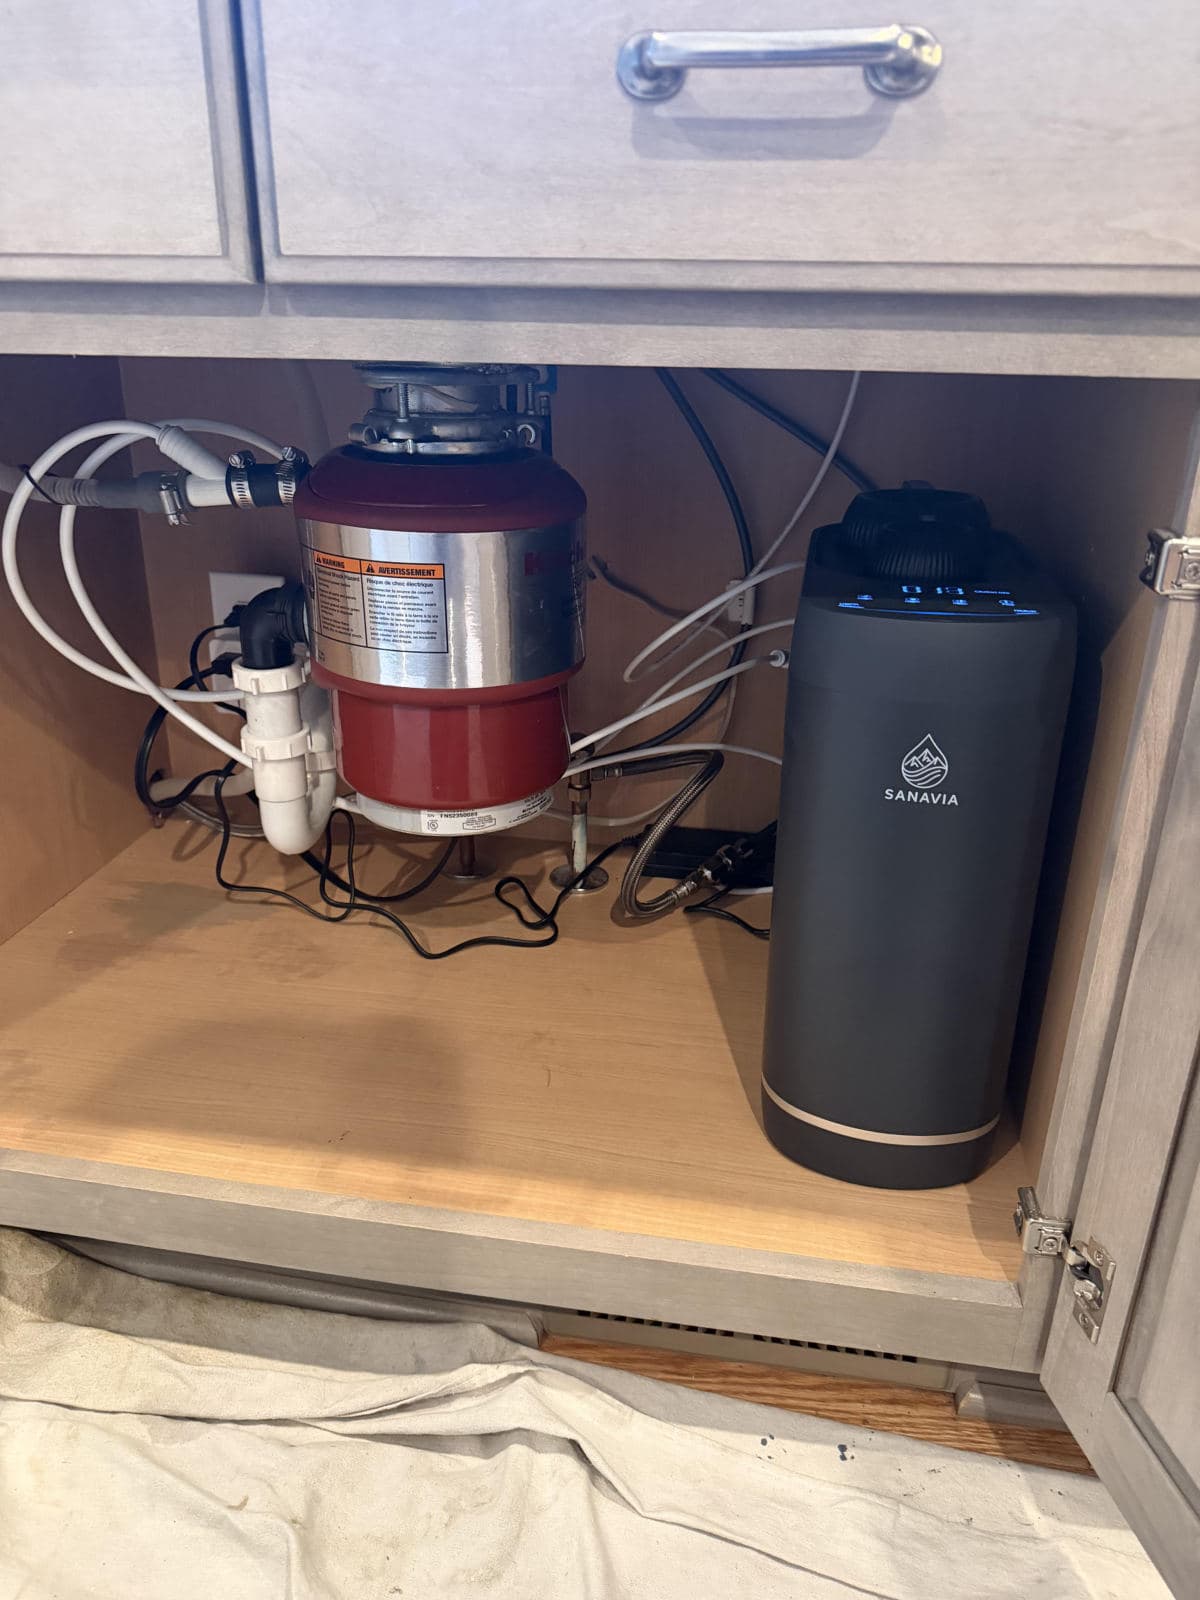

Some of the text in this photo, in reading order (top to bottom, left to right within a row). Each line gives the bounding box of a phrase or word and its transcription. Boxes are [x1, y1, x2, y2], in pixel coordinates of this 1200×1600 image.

[322, 557, 345, 569] WARNING
[378, 565, 436, 577] AVERTISSEMENT
[884, 788, 959, 806] SANAVIA
